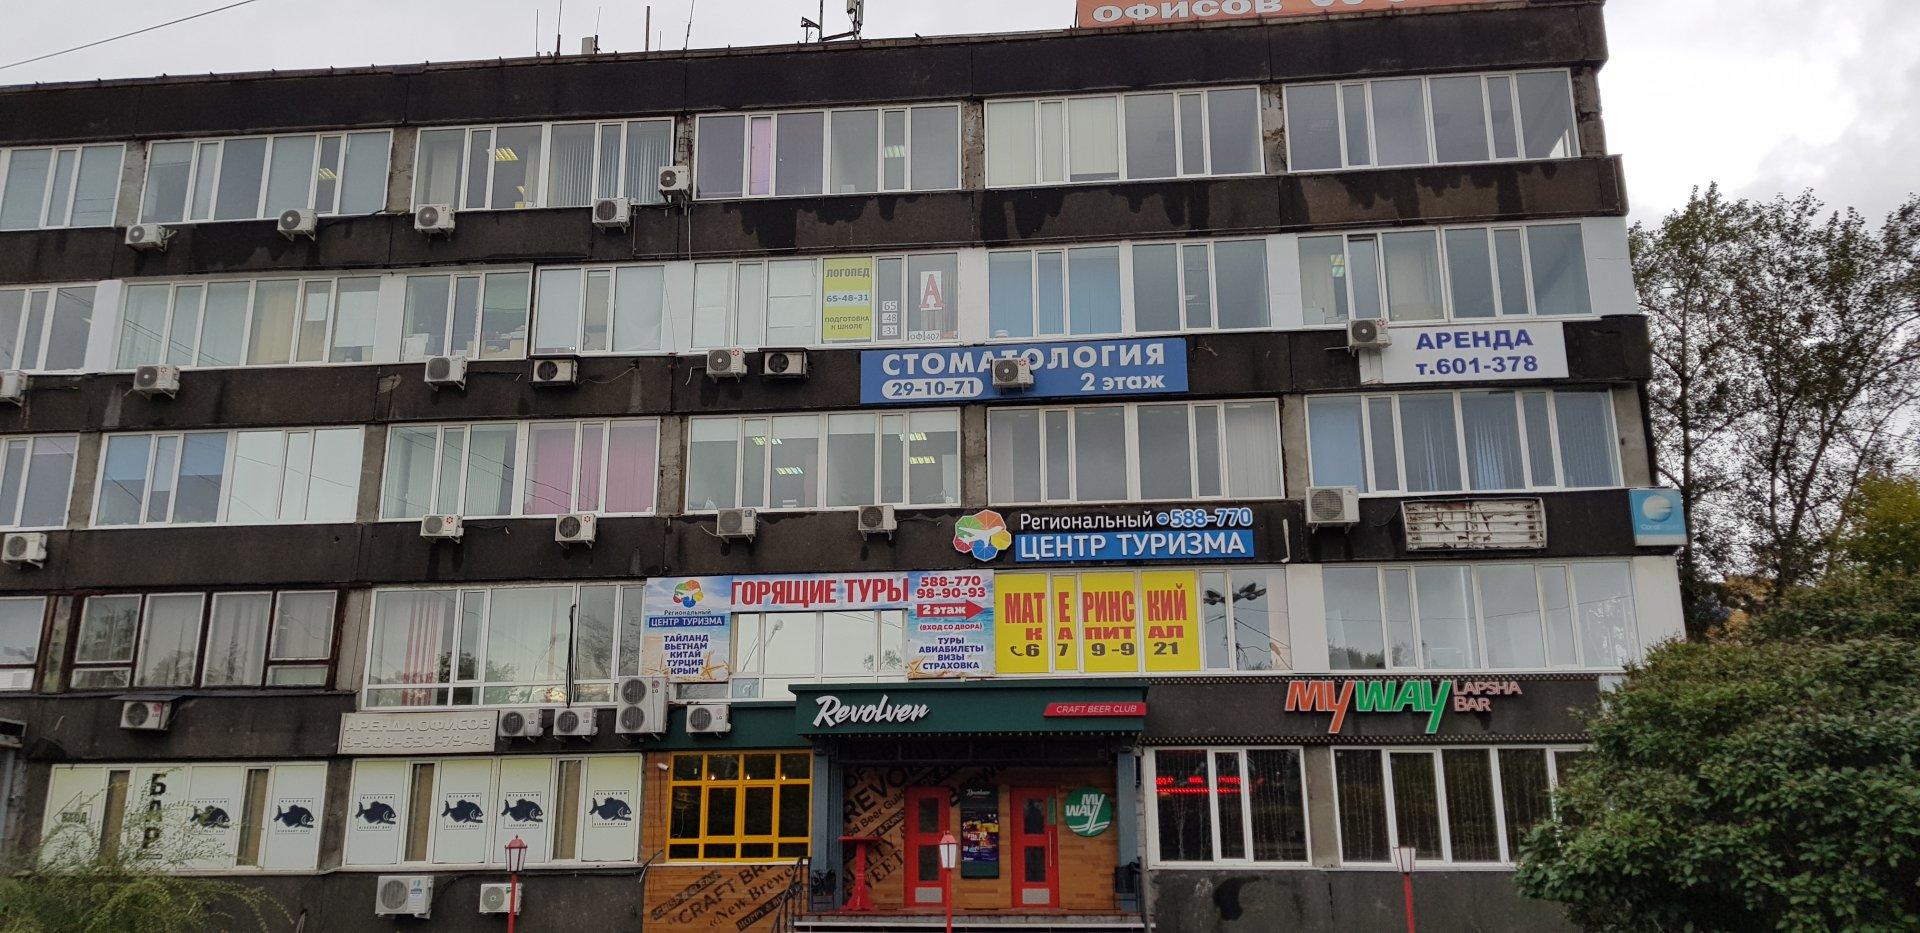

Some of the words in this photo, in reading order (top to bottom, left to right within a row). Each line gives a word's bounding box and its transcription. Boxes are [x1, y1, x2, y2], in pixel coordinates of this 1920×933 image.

[826, 268, 870, 278] ЛОГОПЕД
[826, 294, 869, 302] 65-48-31
[884, 302, 897, 311] 65
[825, 315, 870, 323] ПОДГОТОВКА
[1416, 329, 1534, 350] АРЕНДА
[1416, 355, 1538, 375] т.601-378
[1081, 373, 1096, 391] 2
[1102, 375, 1166, 390] этаж
[891, 380, 975, 396] 29-10-71
[1020, 511, 1152, 530] Региональный
[1169, 508, 1253, 528] 588-770
[1020, 535, 1106, 560] ЦЕНТР
[1116, 532, 1246, 556] ТУРИЗМА
[921, 576, 981, 587] 588-770
[731, 580, 837, 608] ГОРЯЩИЕ
[844, 578, 908, 603] ТУРЫ
[917, 587, 986, 598] 98-90-93
[922, 605, 931, 615] 2
[933, 606, 967, 615] этаж
[651, 617, 680, 627] ЦЕНТР
[682, 616, 723, 626] ТУРИЗМА
[955, 623, 982, 631] ДВОРА)
[664, 634, 709, 643] ТАЙЛАНД
[938, 637, 964, 645] ТУРЫ
[670, 649, 701, 658] КИТАЙ
[919, 645, 984, 653] АВИАБИЛЕТЫ
[938, 653, 964, 661] ВИЗЫ
[666, 659, 704, 667] ТУРЦИЯ
[1453, 680, 1522, 695] LAPSHA
[1056, 705, 1085, 713] CRAFT
[1087, 705, 1111, 713] BEER
[1113, 705, 1137, 713] CLUB
[1453, 696, 1491, 711] BAR
[813, 694, 930, 727] Revolver
[345, 720, 414, 732] АРЕНДА
[417, 719, 491, 731] ОФИСОВ
